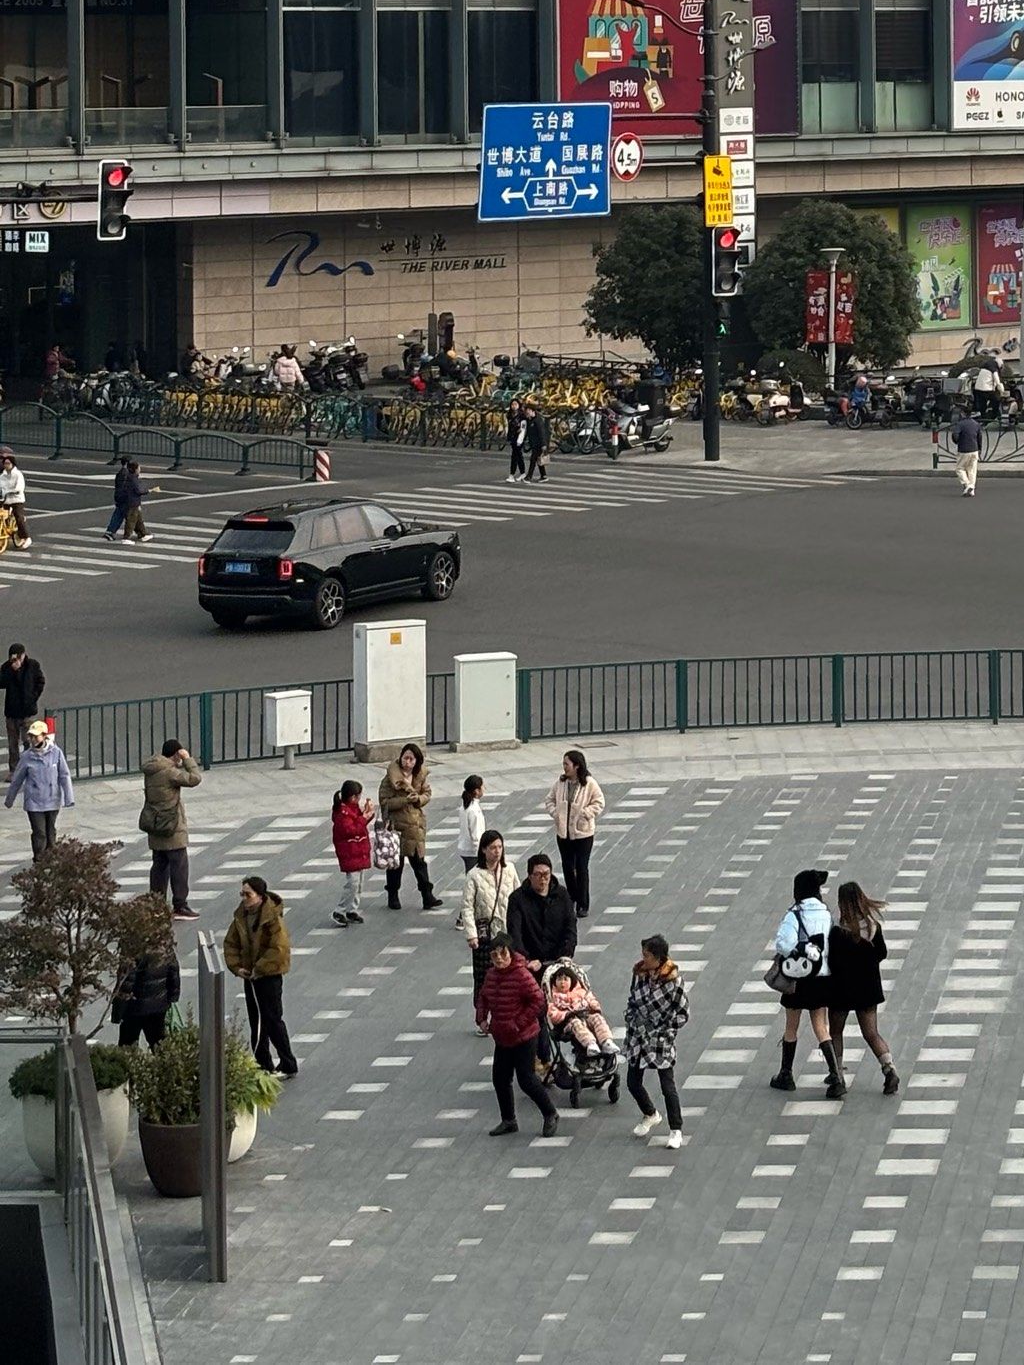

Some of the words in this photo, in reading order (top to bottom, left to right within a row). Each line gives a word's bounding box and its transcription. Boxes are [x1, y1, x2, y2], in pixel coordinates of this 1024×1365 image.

[609, 80, 638, 98] 购物
[612, 102, 641, 110] HOPPING
[532, 111, 574, 129] 云台路
[487, 145, 542, 166] 世博大道
[562, 144, 604, 162] 国展路
[533, 181, 568, 197] 上南路
[28, 233, 47, 244] MIX
[401, 261, 426, 274] THE
[431, 259, 470, 273] RIVER
[473, 257, 507, 271] MALL
